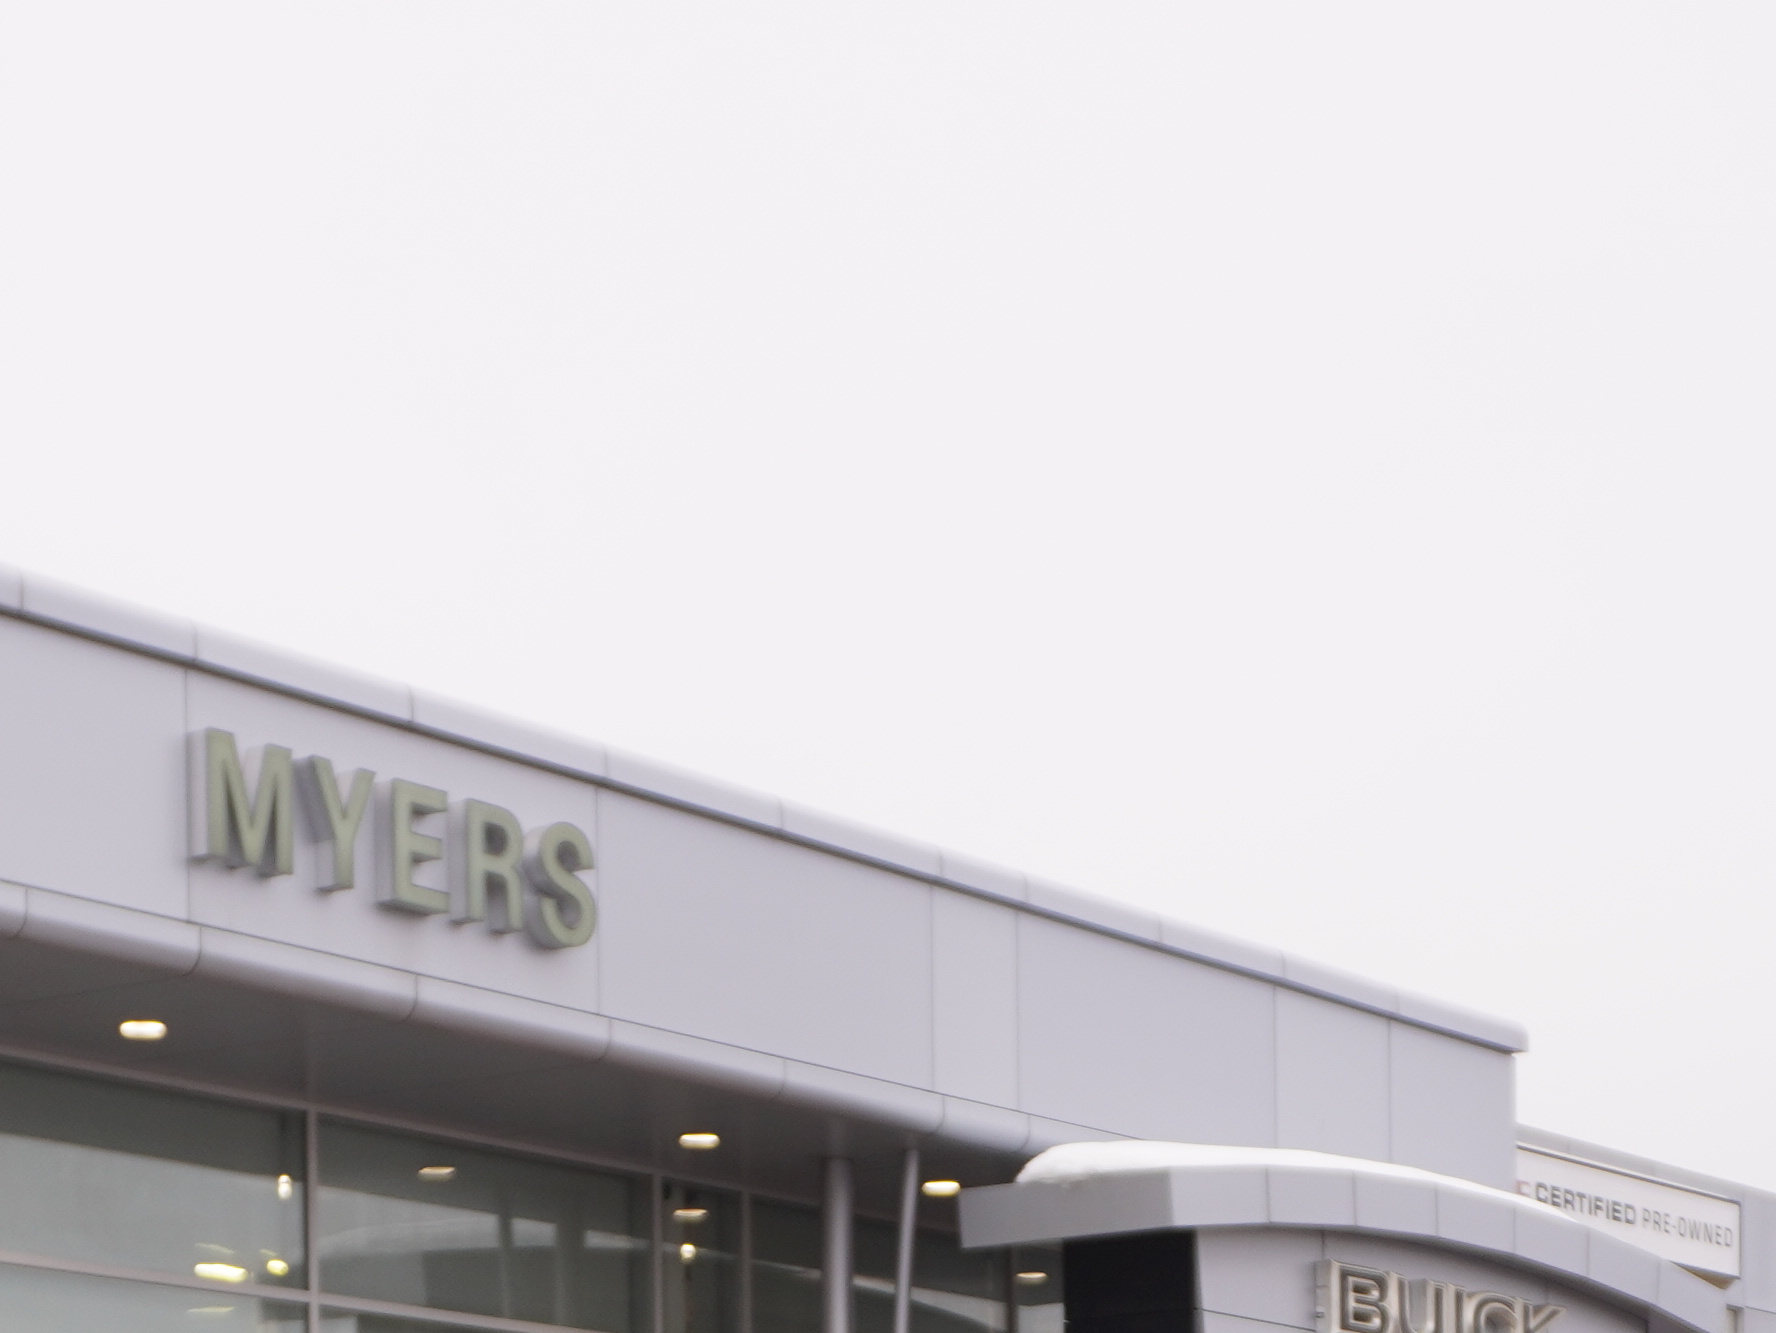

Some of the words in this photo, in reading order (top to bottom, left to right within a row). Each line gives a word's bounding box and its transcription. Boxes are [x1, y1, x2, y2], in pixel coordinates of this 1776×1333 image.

[187, 727, 597, 949] MYERS
[1535, 1181, 1637, 1226] CERTIFIED
[1642, 1207, 1734, 1248] PRE-OWNED
